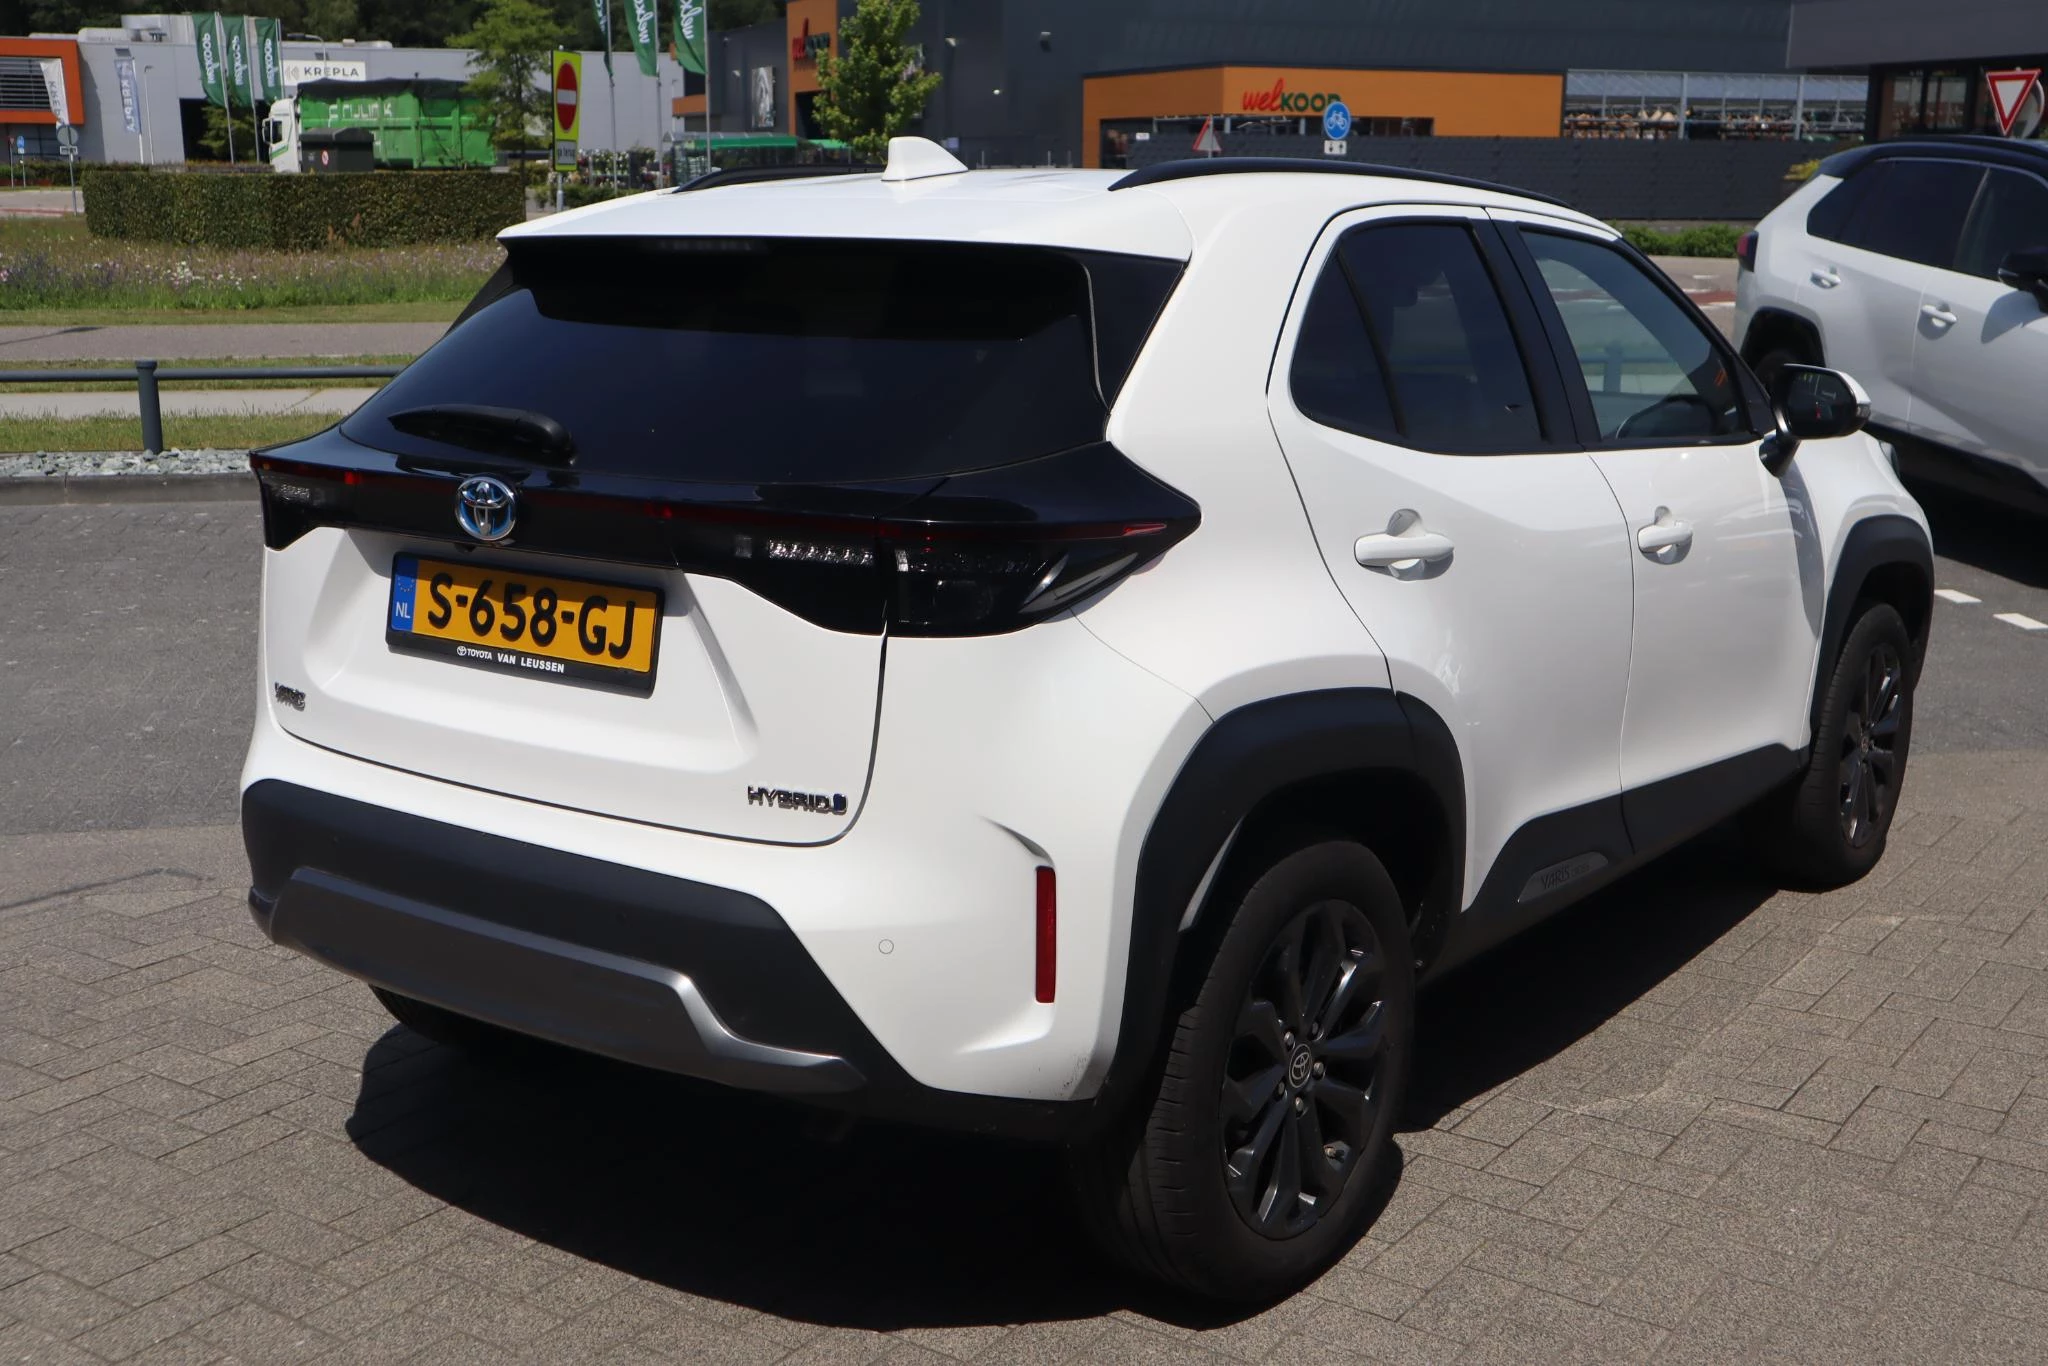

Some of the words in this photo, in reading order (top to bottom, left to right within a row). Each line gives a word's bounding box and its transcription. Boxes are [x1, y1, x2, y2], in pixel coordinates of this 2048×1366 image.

[303, 66, 360, 77] KREPLA
[395, 601, 411, 619] NL
[427, 572, 636, 660] S-658-GJ
[467, 648, 492, 660] TOYOTA
[497, 652, 516, 665] VAN
[521, 657, 565, 673] LEUSSEN
[747, 785, 831, 815] HYBRID
